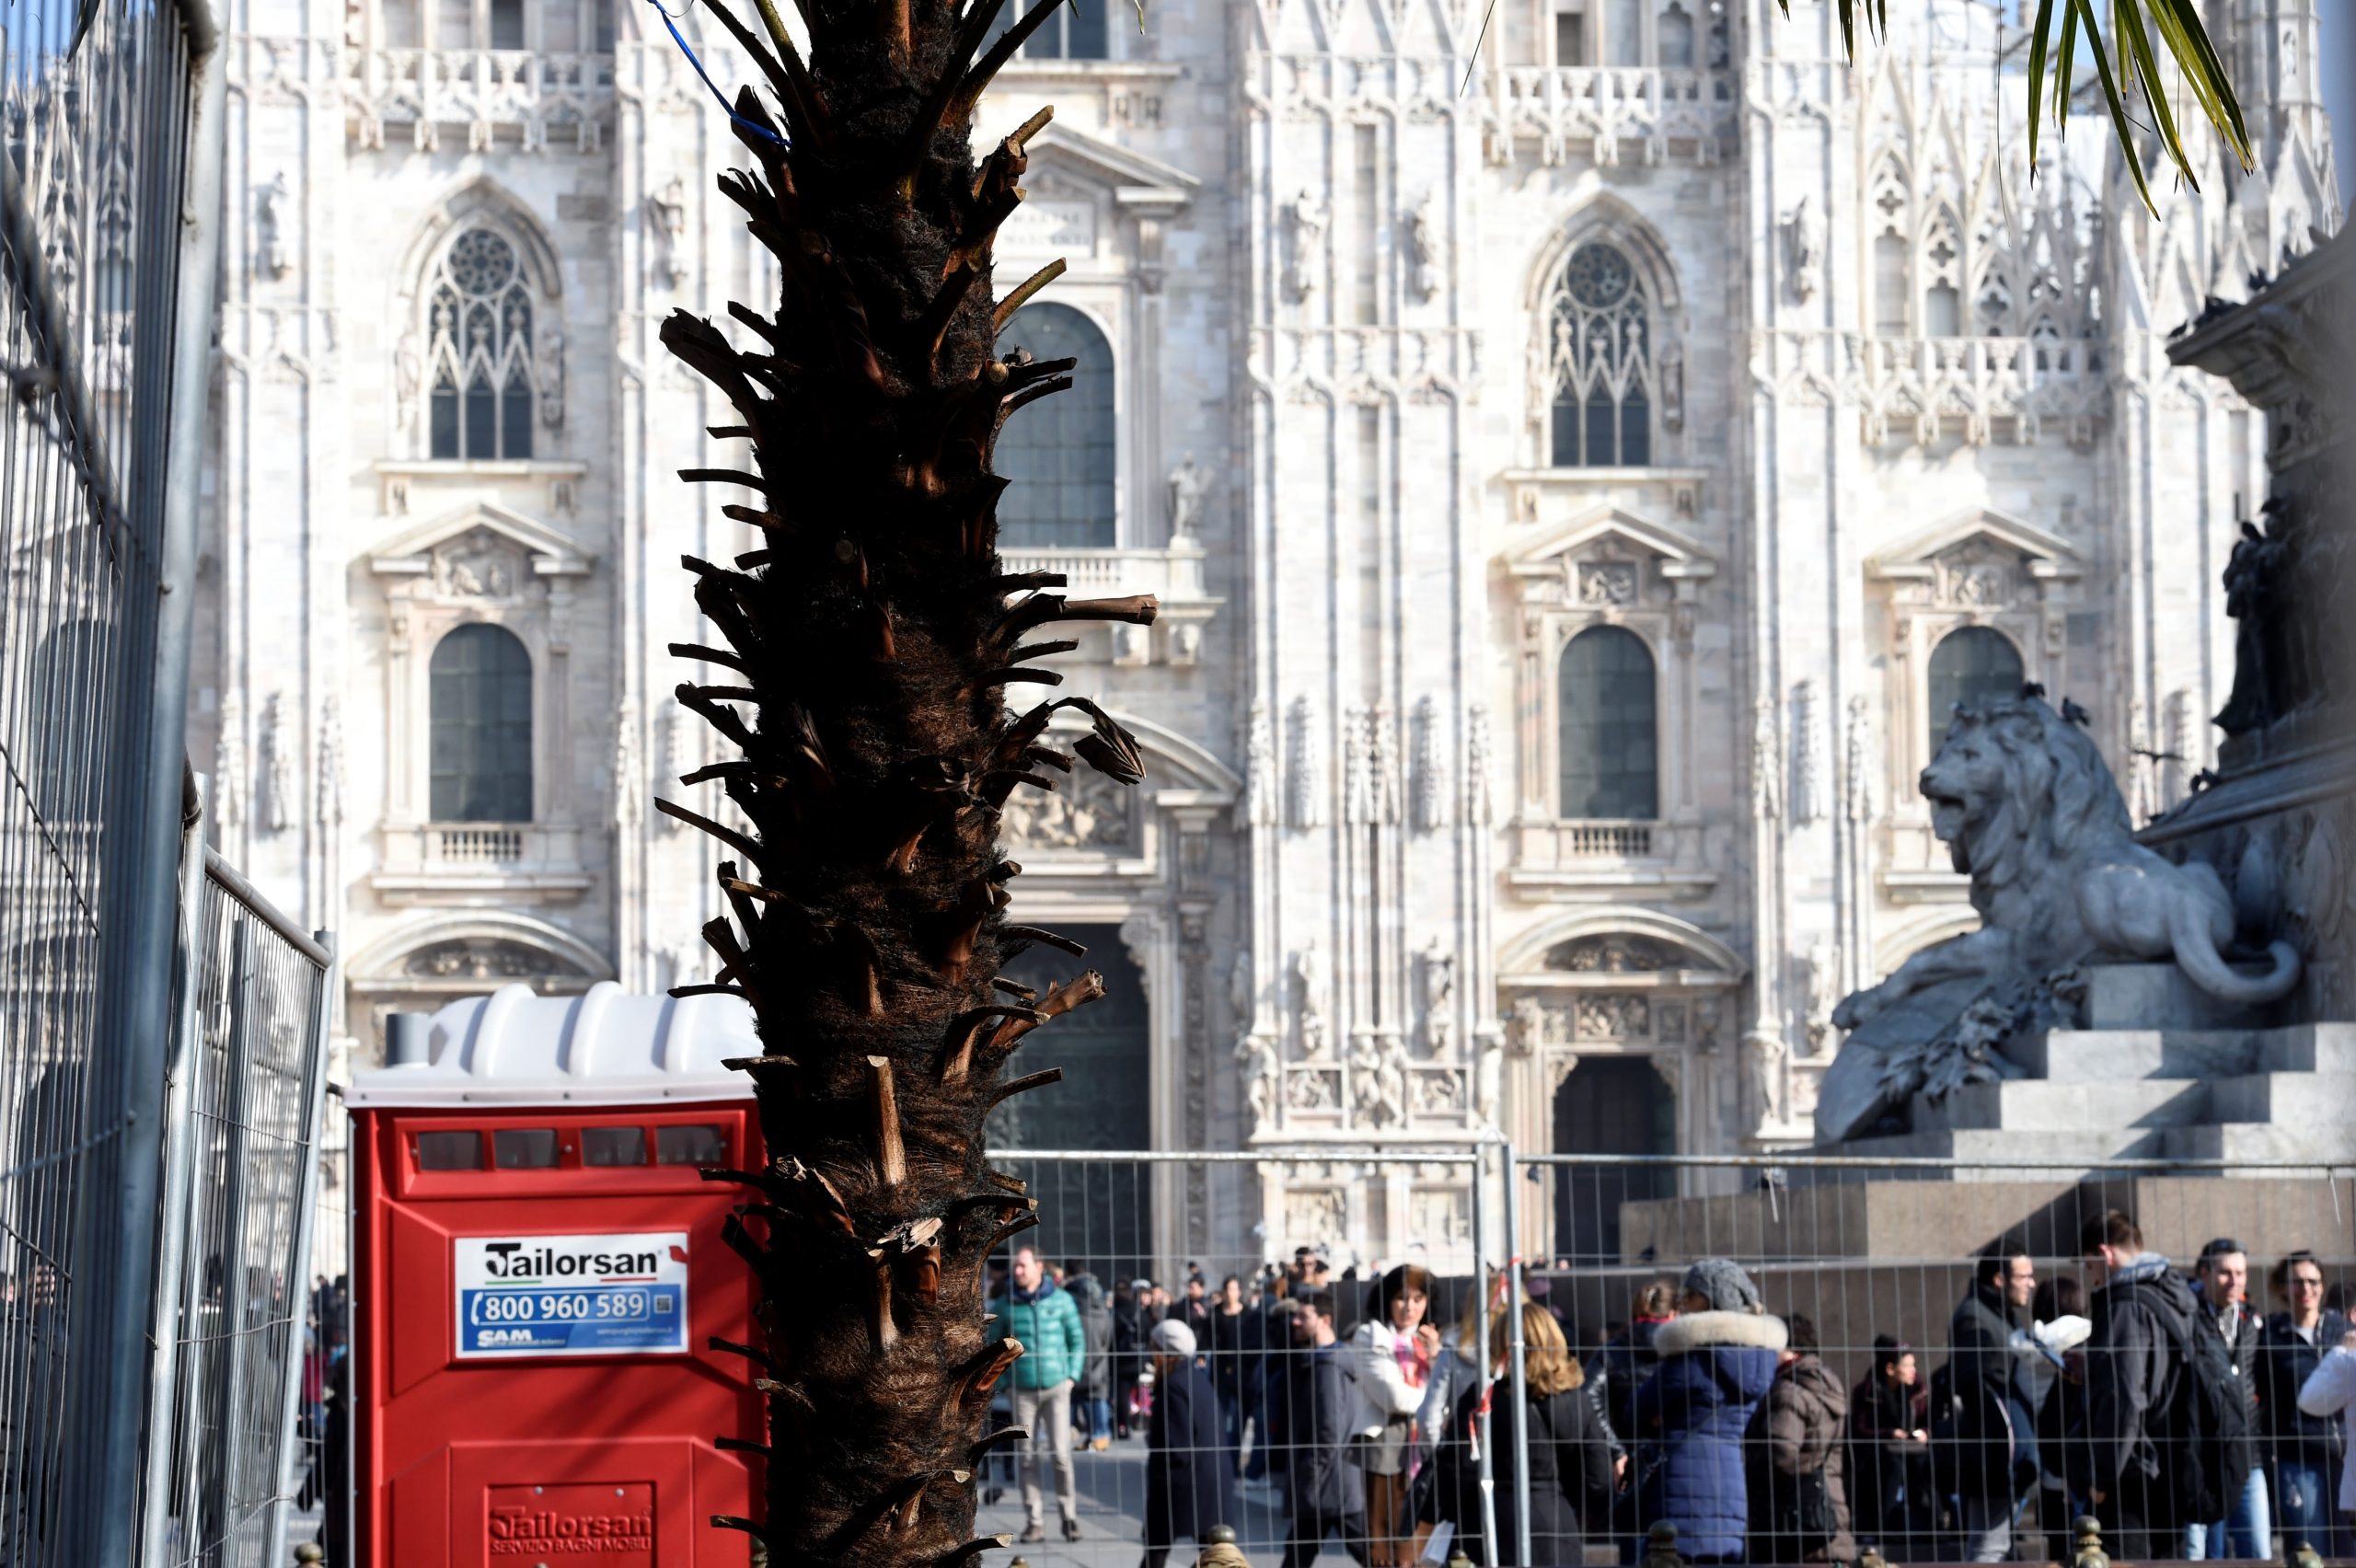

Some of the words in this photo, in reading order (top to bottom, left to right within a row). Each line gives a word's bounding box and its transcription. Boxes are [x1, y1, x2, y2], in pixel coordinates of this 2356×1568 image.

[485, 1242, 657, 1277] Tailorsan
[485, 1296, 534, 1321] 800
[540, 1295, 589, 1320] 960
[596, 1293, 643, 1318] 589
[477, 1329, 533, 1348] SAM
[489, 1507, 652, 1539] Tailorsan
